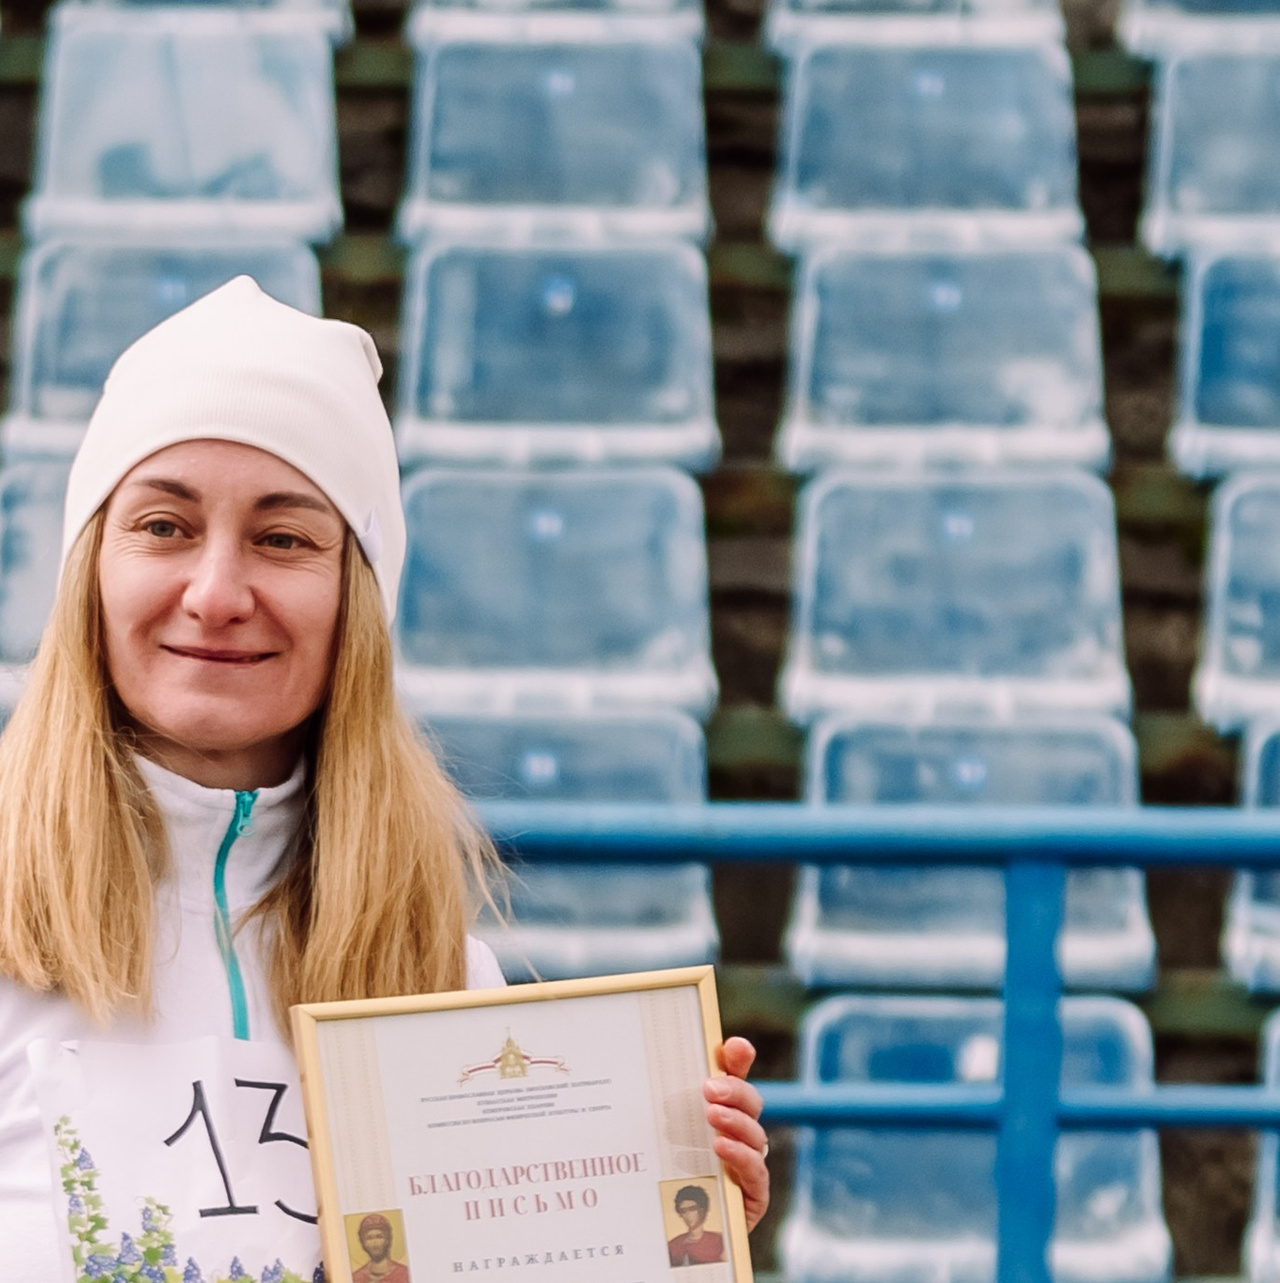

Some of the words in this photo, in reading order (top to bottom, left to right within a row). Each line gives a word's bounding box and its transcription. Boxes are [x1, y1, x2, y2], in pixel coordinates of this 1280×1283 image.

[163, 1078, 318, 1225] 13
[409, 1152, 646, 1196] БЛАГОДАРСТВЕННОЕ
[465, 1188, 598, 1220] ПИСЬМО
[453, 1244, 624, 1272] НАГРАЖДАЕТСЯ
